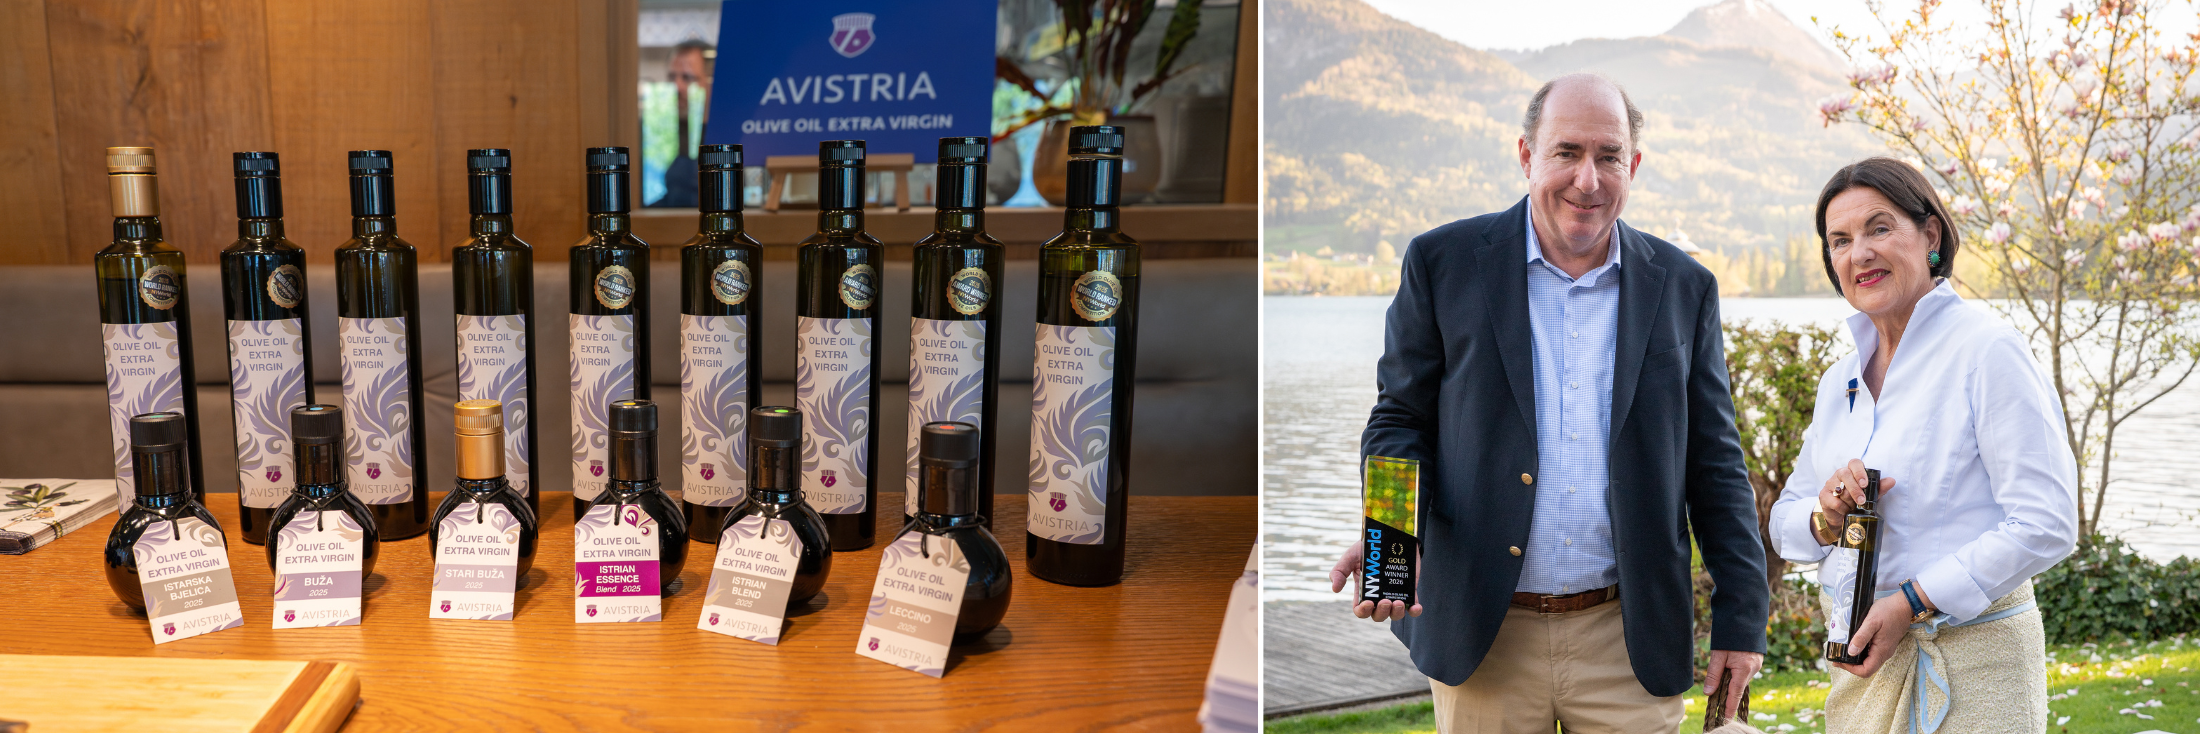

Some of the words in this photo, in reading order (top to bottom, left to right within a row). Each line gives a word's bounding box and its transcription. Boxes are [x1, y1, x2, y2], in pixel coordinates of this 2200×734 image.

[760, 71, 937, 105] AVISTRIA
[741, 118, 791, 134] OLIVE
[794, 117, 823, 132] OIL
[828, 115, 886, 132] EXTRA
[889, 113, 953, 130] VIRGIN
[144, 280, 162, 290] WORLD
[1084, 276, 1102, 284] WORLD
[1104, 277, 1116, 286] OLIVE
[1078, 285, 1097, 298] WORLD
[1096, 292, 1117, 306] RANKED
[1083, 296, 1106, 309] NYWorld
[1076, 300, 1106, 316] COMPETITION
[347, 336, 372, 344] OLIVE
[374, 336, 390, 344] OIL
[467, 333, 493, 341] OLIVE
[496, 333, 512, 341] OIL
[576, 332, 599, 341] OLIVE
[602, 333, 617, 341] OIL
[688, 333, 711, 342] OLIVE
[713, 334, 730, 342] OIL
[809, 336, 836, 346] OLIVE
[839, 337, 856, 346] OIL
[113, 342, 140, 350] OLIVE
[144, 342, 162, 350] OIL
[242, 338, 270, 347] OLIVE
[272, 337, 288, 346] OIL
[920, 338, 947, 348] OLIVE
[950, 340, 967, 349] OIL
[353, 348, 383, 356] EXTRA
[474, 346, 505, 354] EXTRA
[581, 345, 610, 354] EXTRA
[692, 346, 722, 355] EXTRA
[815, 350, 848, 359] EXTRA
[1042, 344, 1072, 356] OLIVE
[1074, 346, 1094, 356] OIL
[120, 355, 154, 363] EXTRA
[249, 351, 282, 360] EXTRA
[925, 353, 959, 363] EXTRA
[353, 360, 384, 369] VIRGIN
[474, 358, 506, 366] VIRGIN
[581, 357, 610, 366] VIRGIN
[692, 359, 723, 368] VIRGIN
[1048, 359, 1083, 371] EXTRA
[121, 368, 156, 376] VIRGIN
[250, 363, 283, 372] VIRGIN
[814, 363, 848, 372] VIRGIN
[924, 366, 958, 376] VIRGIN
[1047, 373, 1083, 385] VIRGIN
[250, 487, 293, 498] AVISTR
[353, 483, 401, 494] AVISTRIA
[687, 482, 734, 496] AVISTRIA
[1032, 512, 1089, 532] AVISTRIA
[456, 534, 483, 543] OLIVE
[485, 535, 501, 543] OIL
[593, 537, 623, 546] OLIVE
[625, 537, 641, 545] OIL
[296, 543, 325, 552] OLIVE
[328, 542, 344, 550] OIL
[444, 547, 476, 555] EXTRA
[478, 547, 510, 556] VIRGIN
[156, 551, 187, 564] OLIVE
[190, 548, 207, 558] OIL
[285, 555, 318, 564] EXTRA
[321, 553, 354, 562] VIRGIN
[583, 550, 615, 558] EXTRA
[618, 549, 651, 557] VIRGIN
[735, 547, 762, 560] OLIVE
[764, 553, 780, 563] OIL
[148, 564, 184, 578] EXTRA
[187, 558, 220, 571] VIRGIN
[722, 557, 753, 571] EXTRA
[755, 564, 787, 577] VIRGIN
[1365, 529, 1382, 598] NYWorld
[445, 569, 475, 578] STARI
[477, 568, 505, 579] BUŽA
[599, 565, 636, 573] ISTRIAN
[304, 575, 333, 586] BUŽA
[596, 574, 639, 584] ESSENCE
[897, 566, 926, 581] OLIVE
[928, 574, 945, 586] OIL
[164, 576, 212, 592] ISTARSKA
[732, 576, 766, 590] ISTRIAN
[170, 586, 211, 601] BJELICA
[309, 589, 328, 597] 2025
[622, 585, 641, 593] 2025
[731, 586, 761, 599] BLEND
[883, 577, 916, 593] EXTRA
[918, 586, 953, 603] VIRGIN
[184, 598, 204, 608] 2025
[457, 602, 502, 612] AVISTRIA
[735, 598, 753, 608] 2025
[302, 610, 350, 620] AVISTRIA
[604, 605, 650, 615] AVISTRIA
[889, 605, 932, 624] LECCINO
[183, 612, 232, 630] AVISTRIA
[724, 617, 769, 636] AVISTRIA
[896, 621, 917, 634] 2025
[884, 644, 933, 666] AVISTRIA
